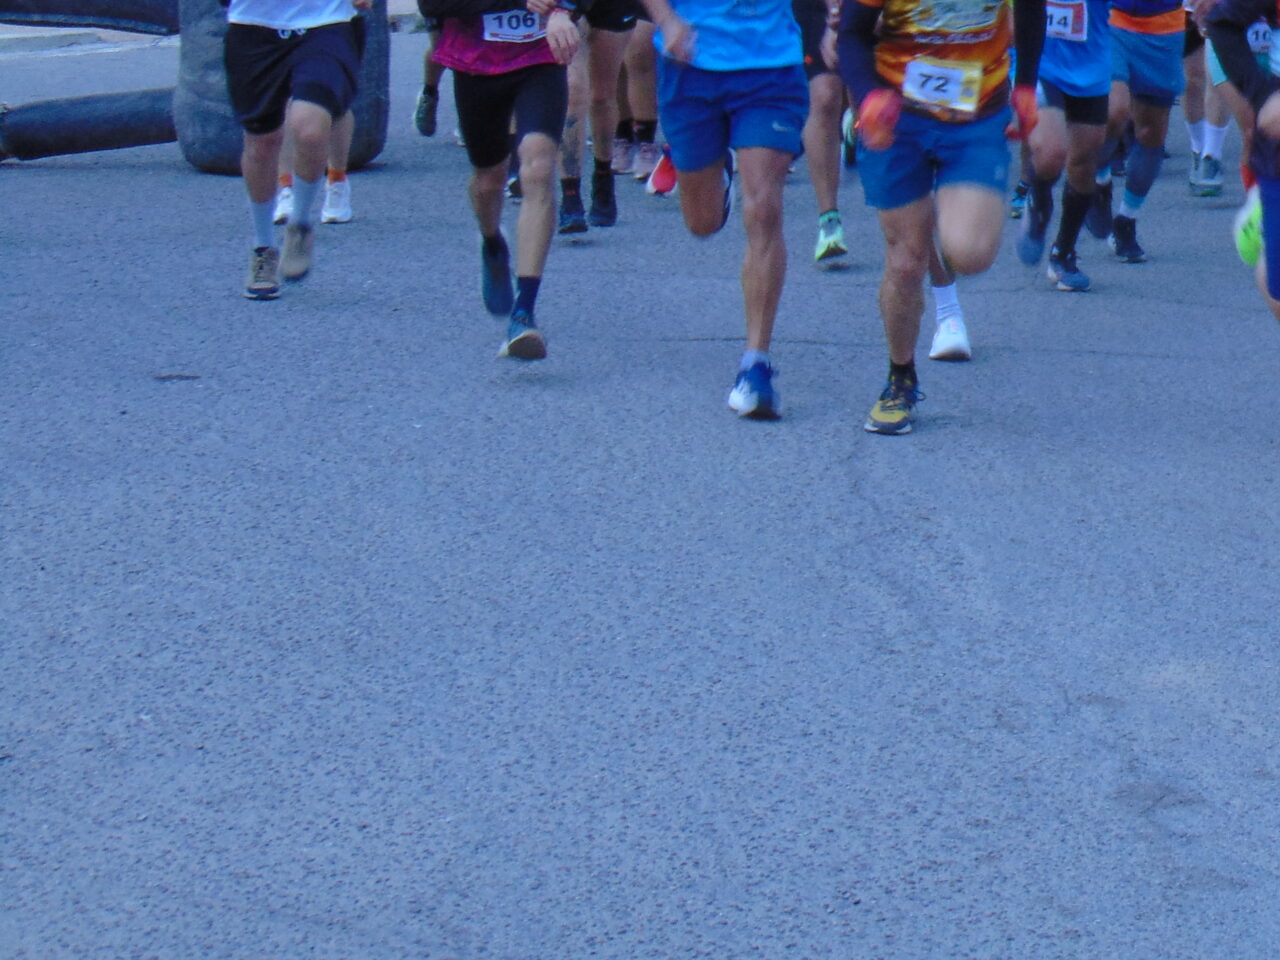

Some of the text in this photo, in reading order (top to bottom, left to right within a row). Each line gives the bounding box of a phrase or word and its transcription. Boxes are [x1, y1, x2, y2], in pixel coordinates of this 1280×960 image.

[492, 11, 536, 30] 106
[1047, 14, 1069, 27] 14
[1252, 30, 1273, 41] 10
[919, 72, 949, 93] 72
